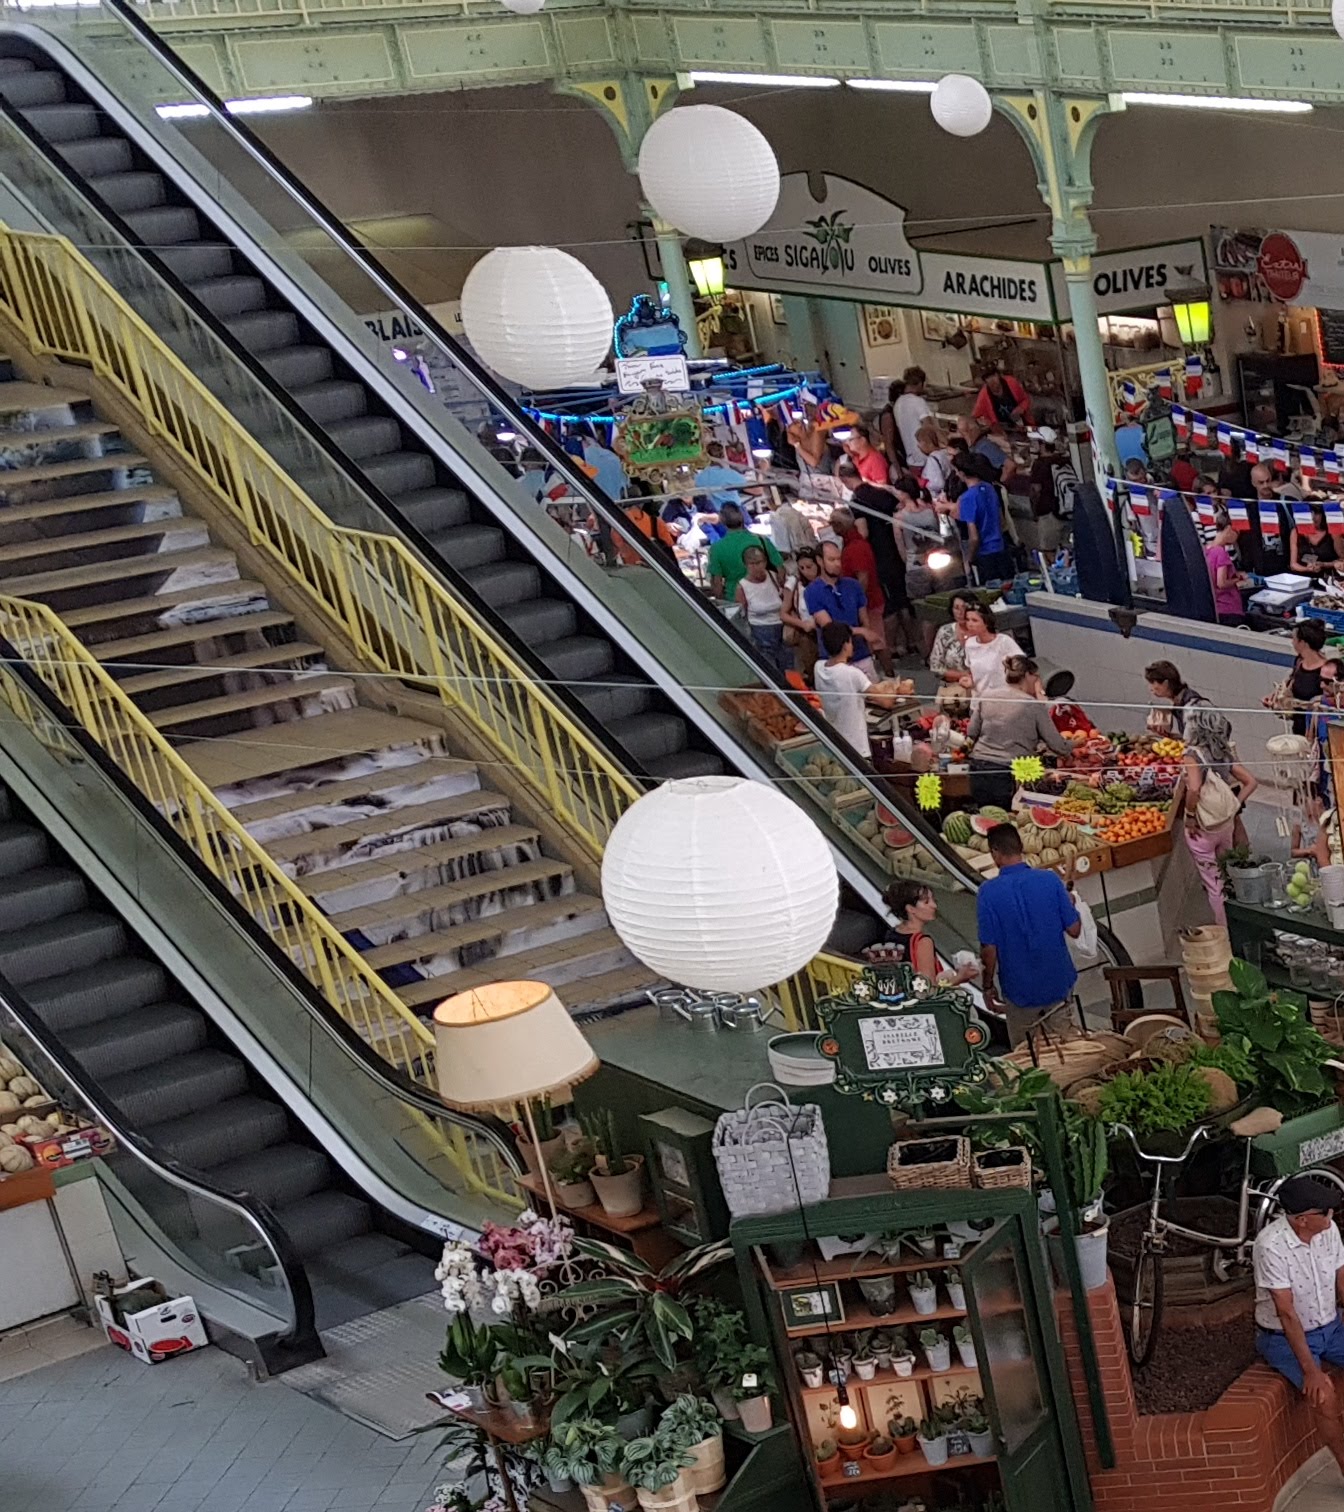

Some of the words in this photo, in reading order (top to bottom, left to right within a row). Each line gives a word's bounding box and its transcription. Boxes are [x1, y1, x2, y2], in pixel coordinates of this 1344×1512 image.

[754, 245, 780, 263] EPICES
[868, 255, 911, 276] OLIVES
[943, 271, 1037, 302] ARACHIDES
[1093, 263, 1168, 296] OLIVES
